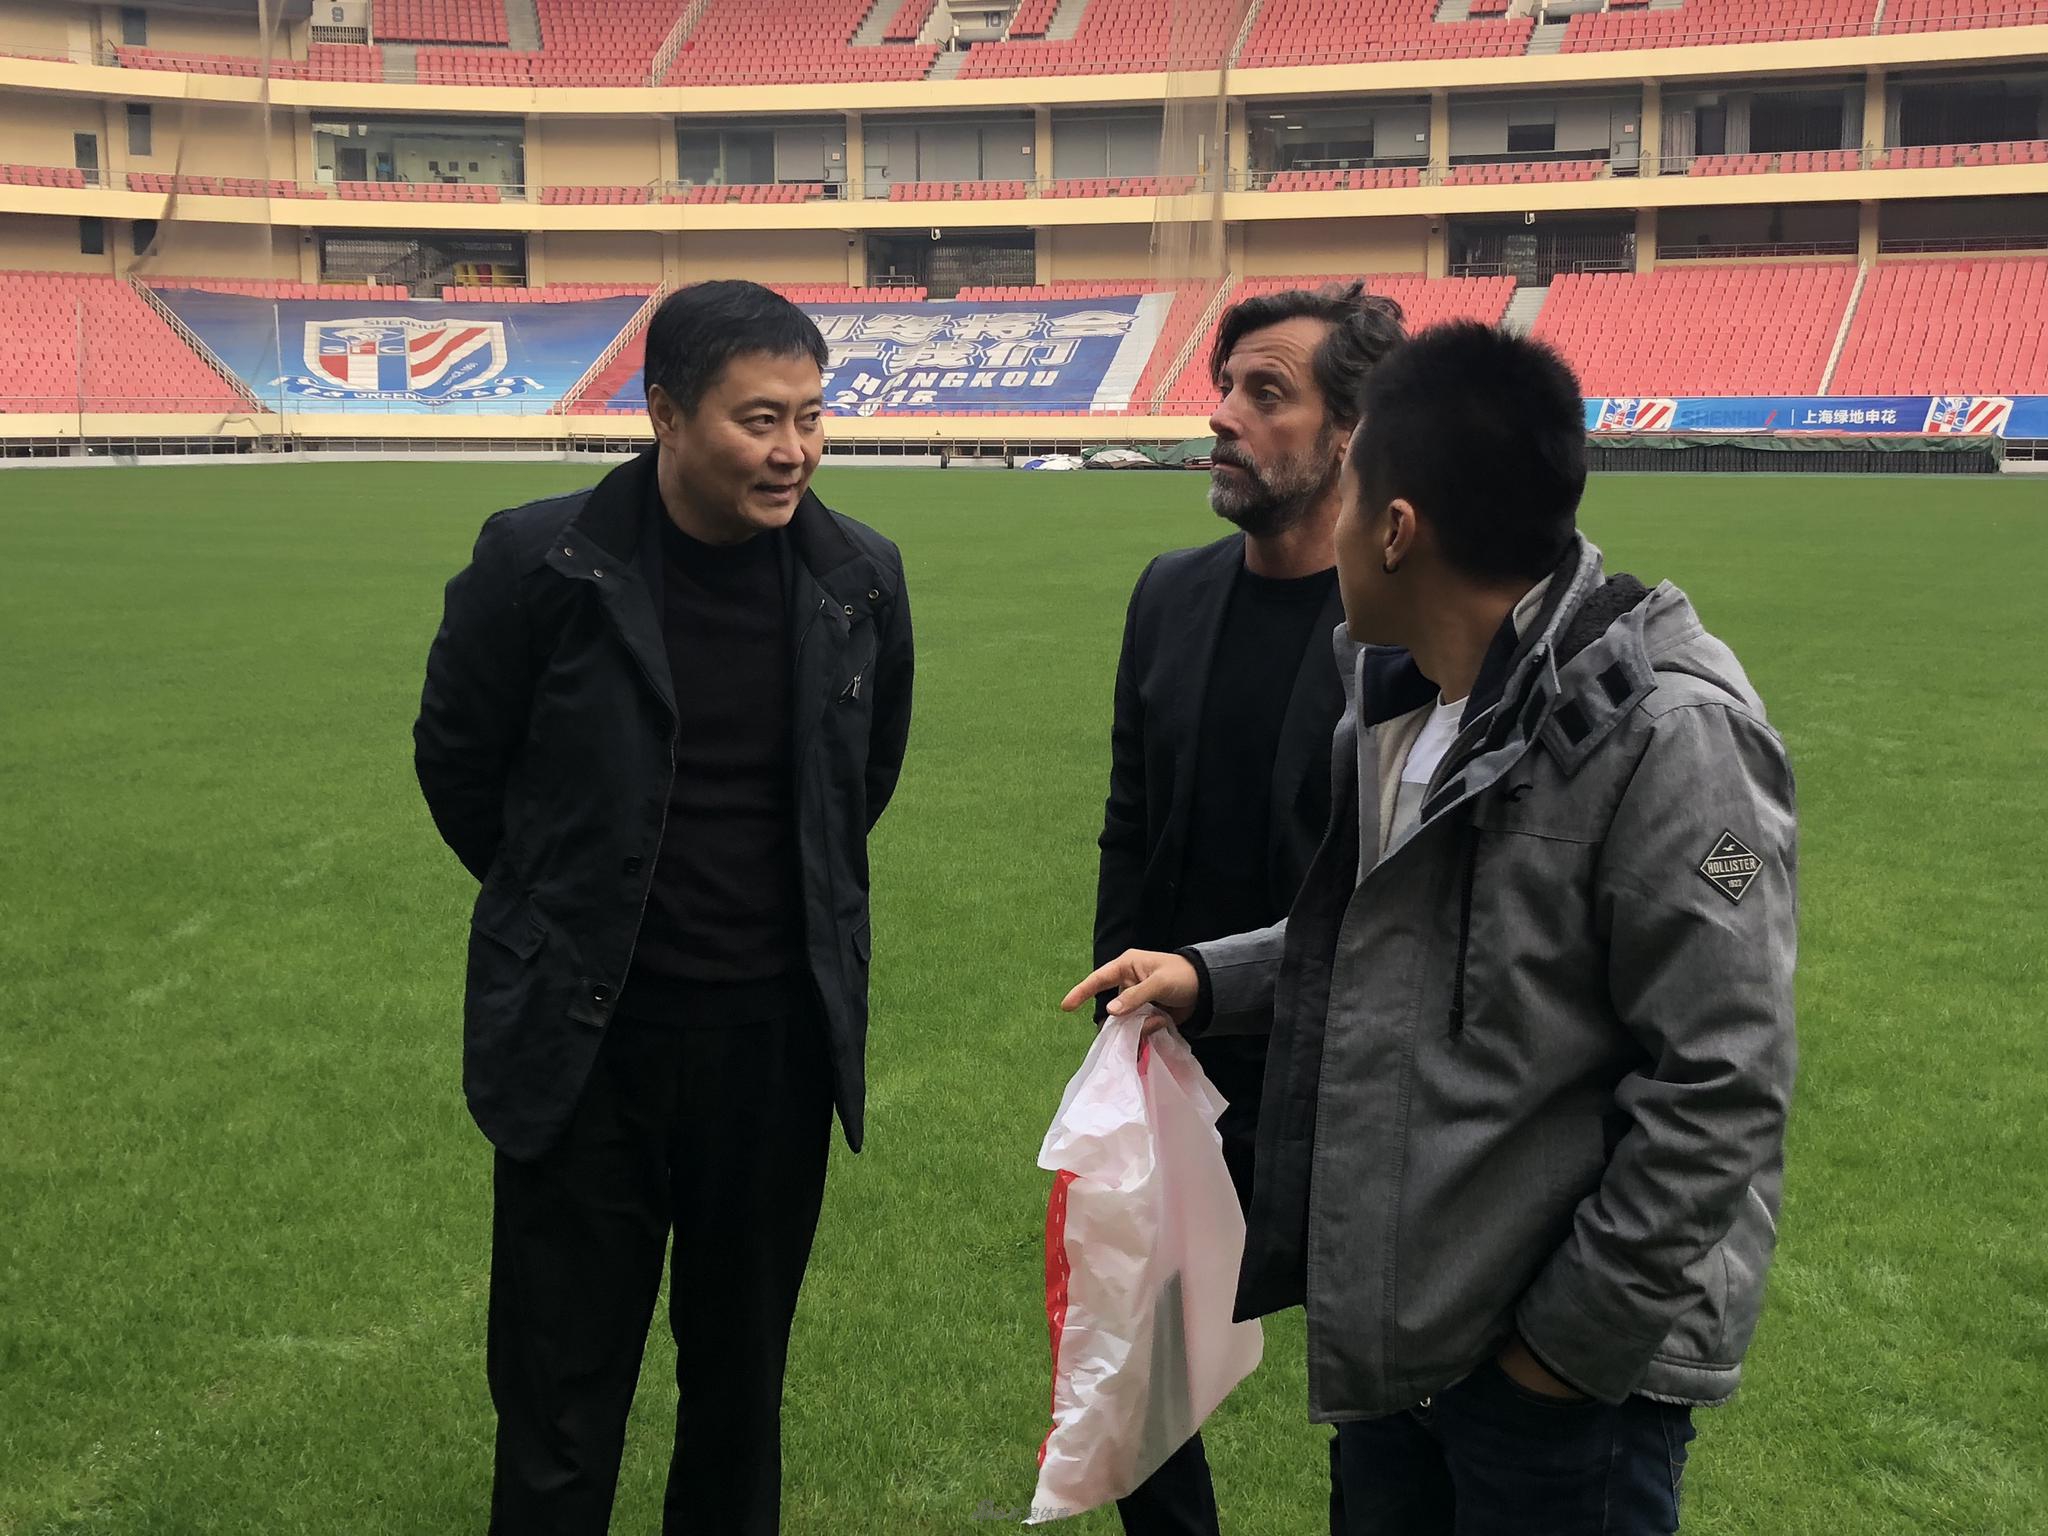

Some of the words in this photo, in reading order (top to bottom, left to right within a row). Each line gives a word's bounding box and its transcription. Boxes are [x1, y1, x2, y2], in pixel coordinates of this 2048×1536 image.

[1801, 409, 1897, 425] 上海绿地申花
[1707, 857, 1757, 874] HOLLISTER
